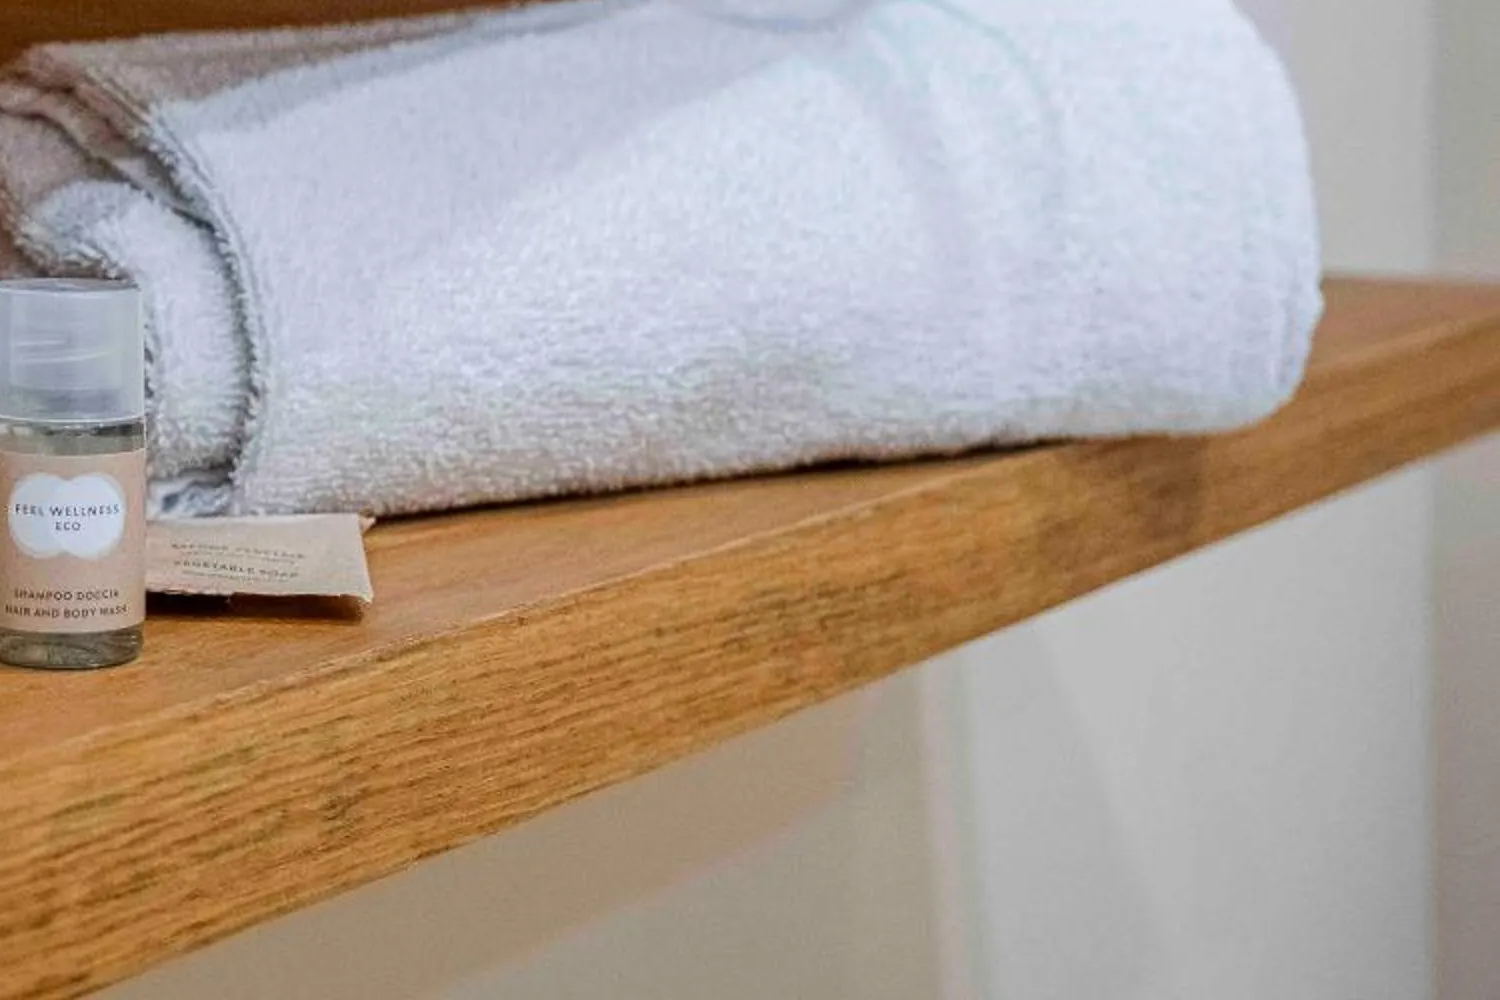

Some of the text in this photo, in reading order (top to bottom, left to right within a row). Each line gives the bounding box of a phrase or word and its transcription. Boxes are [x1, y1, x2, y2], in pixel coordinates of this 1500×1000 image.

[15, 503, 121, 517] FEEL WELLNESS
[55, 521, 81, 531] ECO
[14, 588, 119, 601] SHAMPOO DOCCIA
[5, 604, 31, 616] HAIR
[33, 607, 60, 618] AND
[63, 608, 97, 619] BODY
